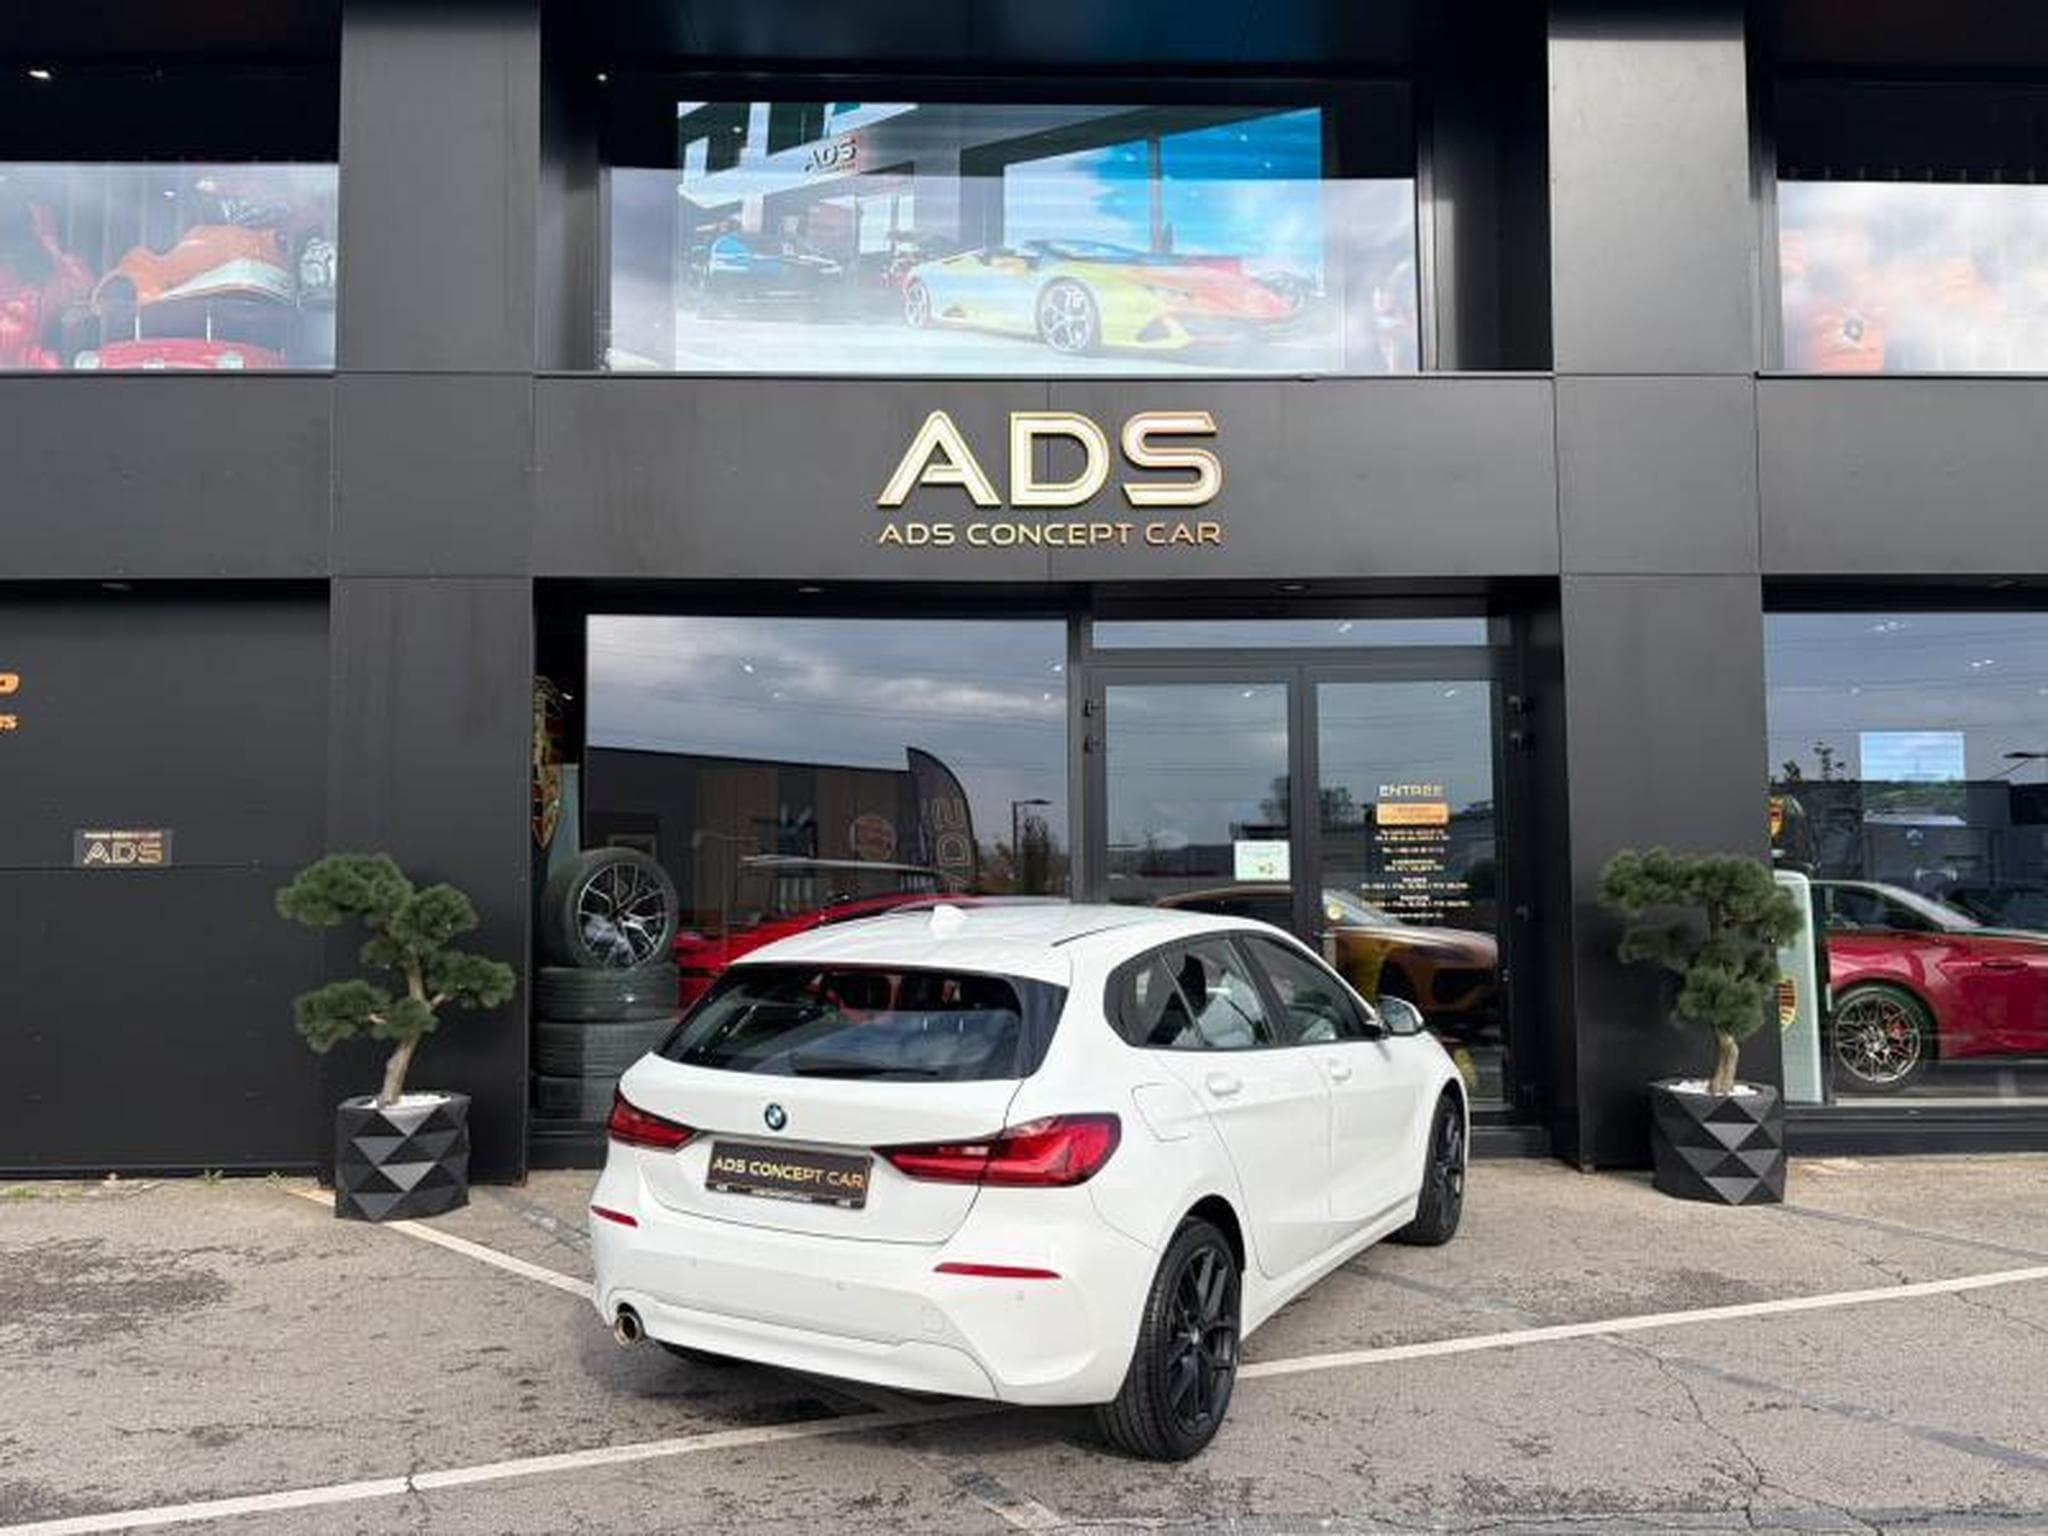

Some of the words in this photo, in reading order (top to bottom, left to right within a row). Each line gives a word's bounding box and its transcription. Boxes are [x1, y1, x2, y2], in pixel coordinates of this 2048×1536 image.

[804, 138, 858, 172] ADS
[876, 408, 1224, 508] ADS
[878, 522, 955, 546] ADS
[966, 522, 1132, 547] CONCEPT
[1144, 522, 1222, 546] CAR
[83, 841, 162, 864] ADS
[713, 1157, 746, 1173] ADS
[749, 1161, 825, 1183] CONCEPT
[827, 1171, 865, 1189] CAR
